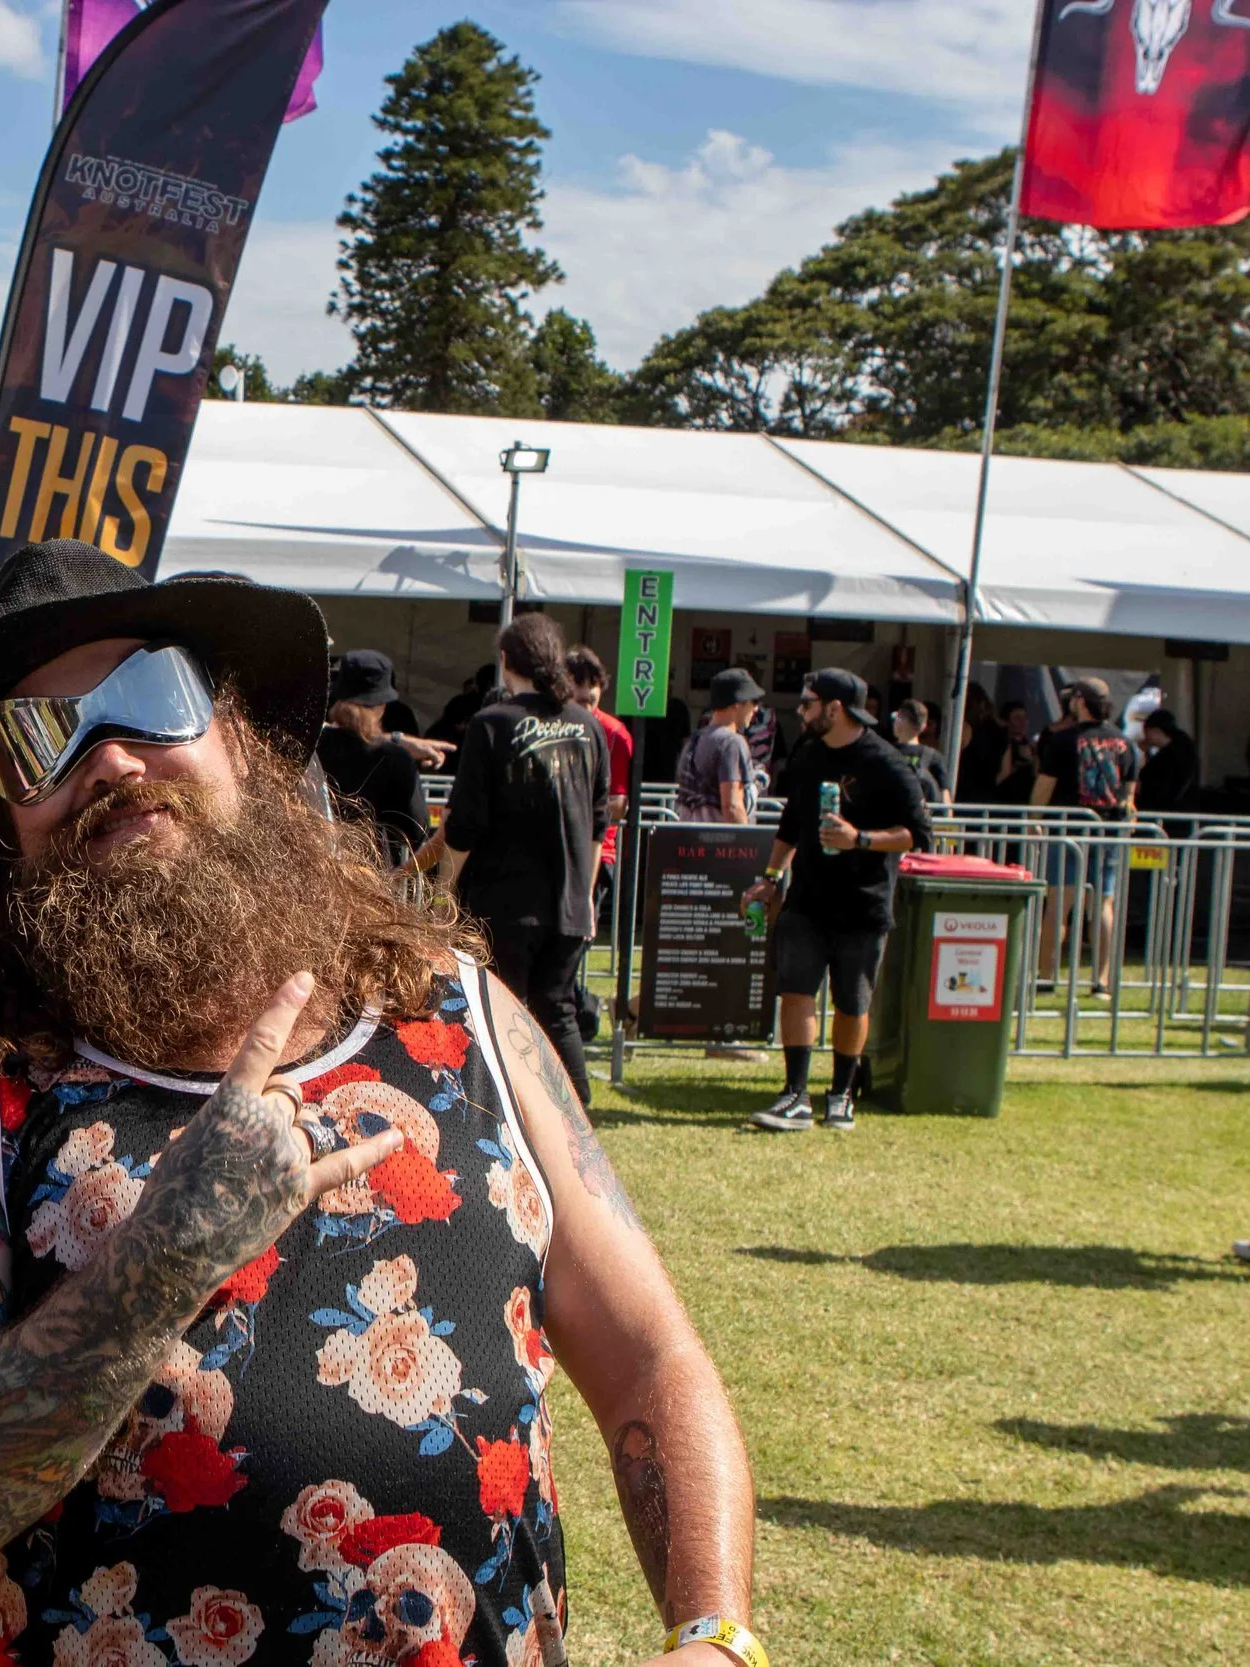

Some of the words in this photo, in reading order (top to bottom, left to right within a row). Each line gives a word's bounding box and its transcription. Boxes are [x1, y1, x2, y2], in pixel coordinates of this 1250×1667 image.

[65, 153, 249, 226] KNOTFEST
[81, 186, 220, 235] AUSTRALIA
[40, 247, 214, 423] VIP
[0, 416, 168, 569] THIS
[631, 575, 660, 710] ENTRY
[677, 846, 706, 859] BAR
[714, 846, 759, 860] MENU
